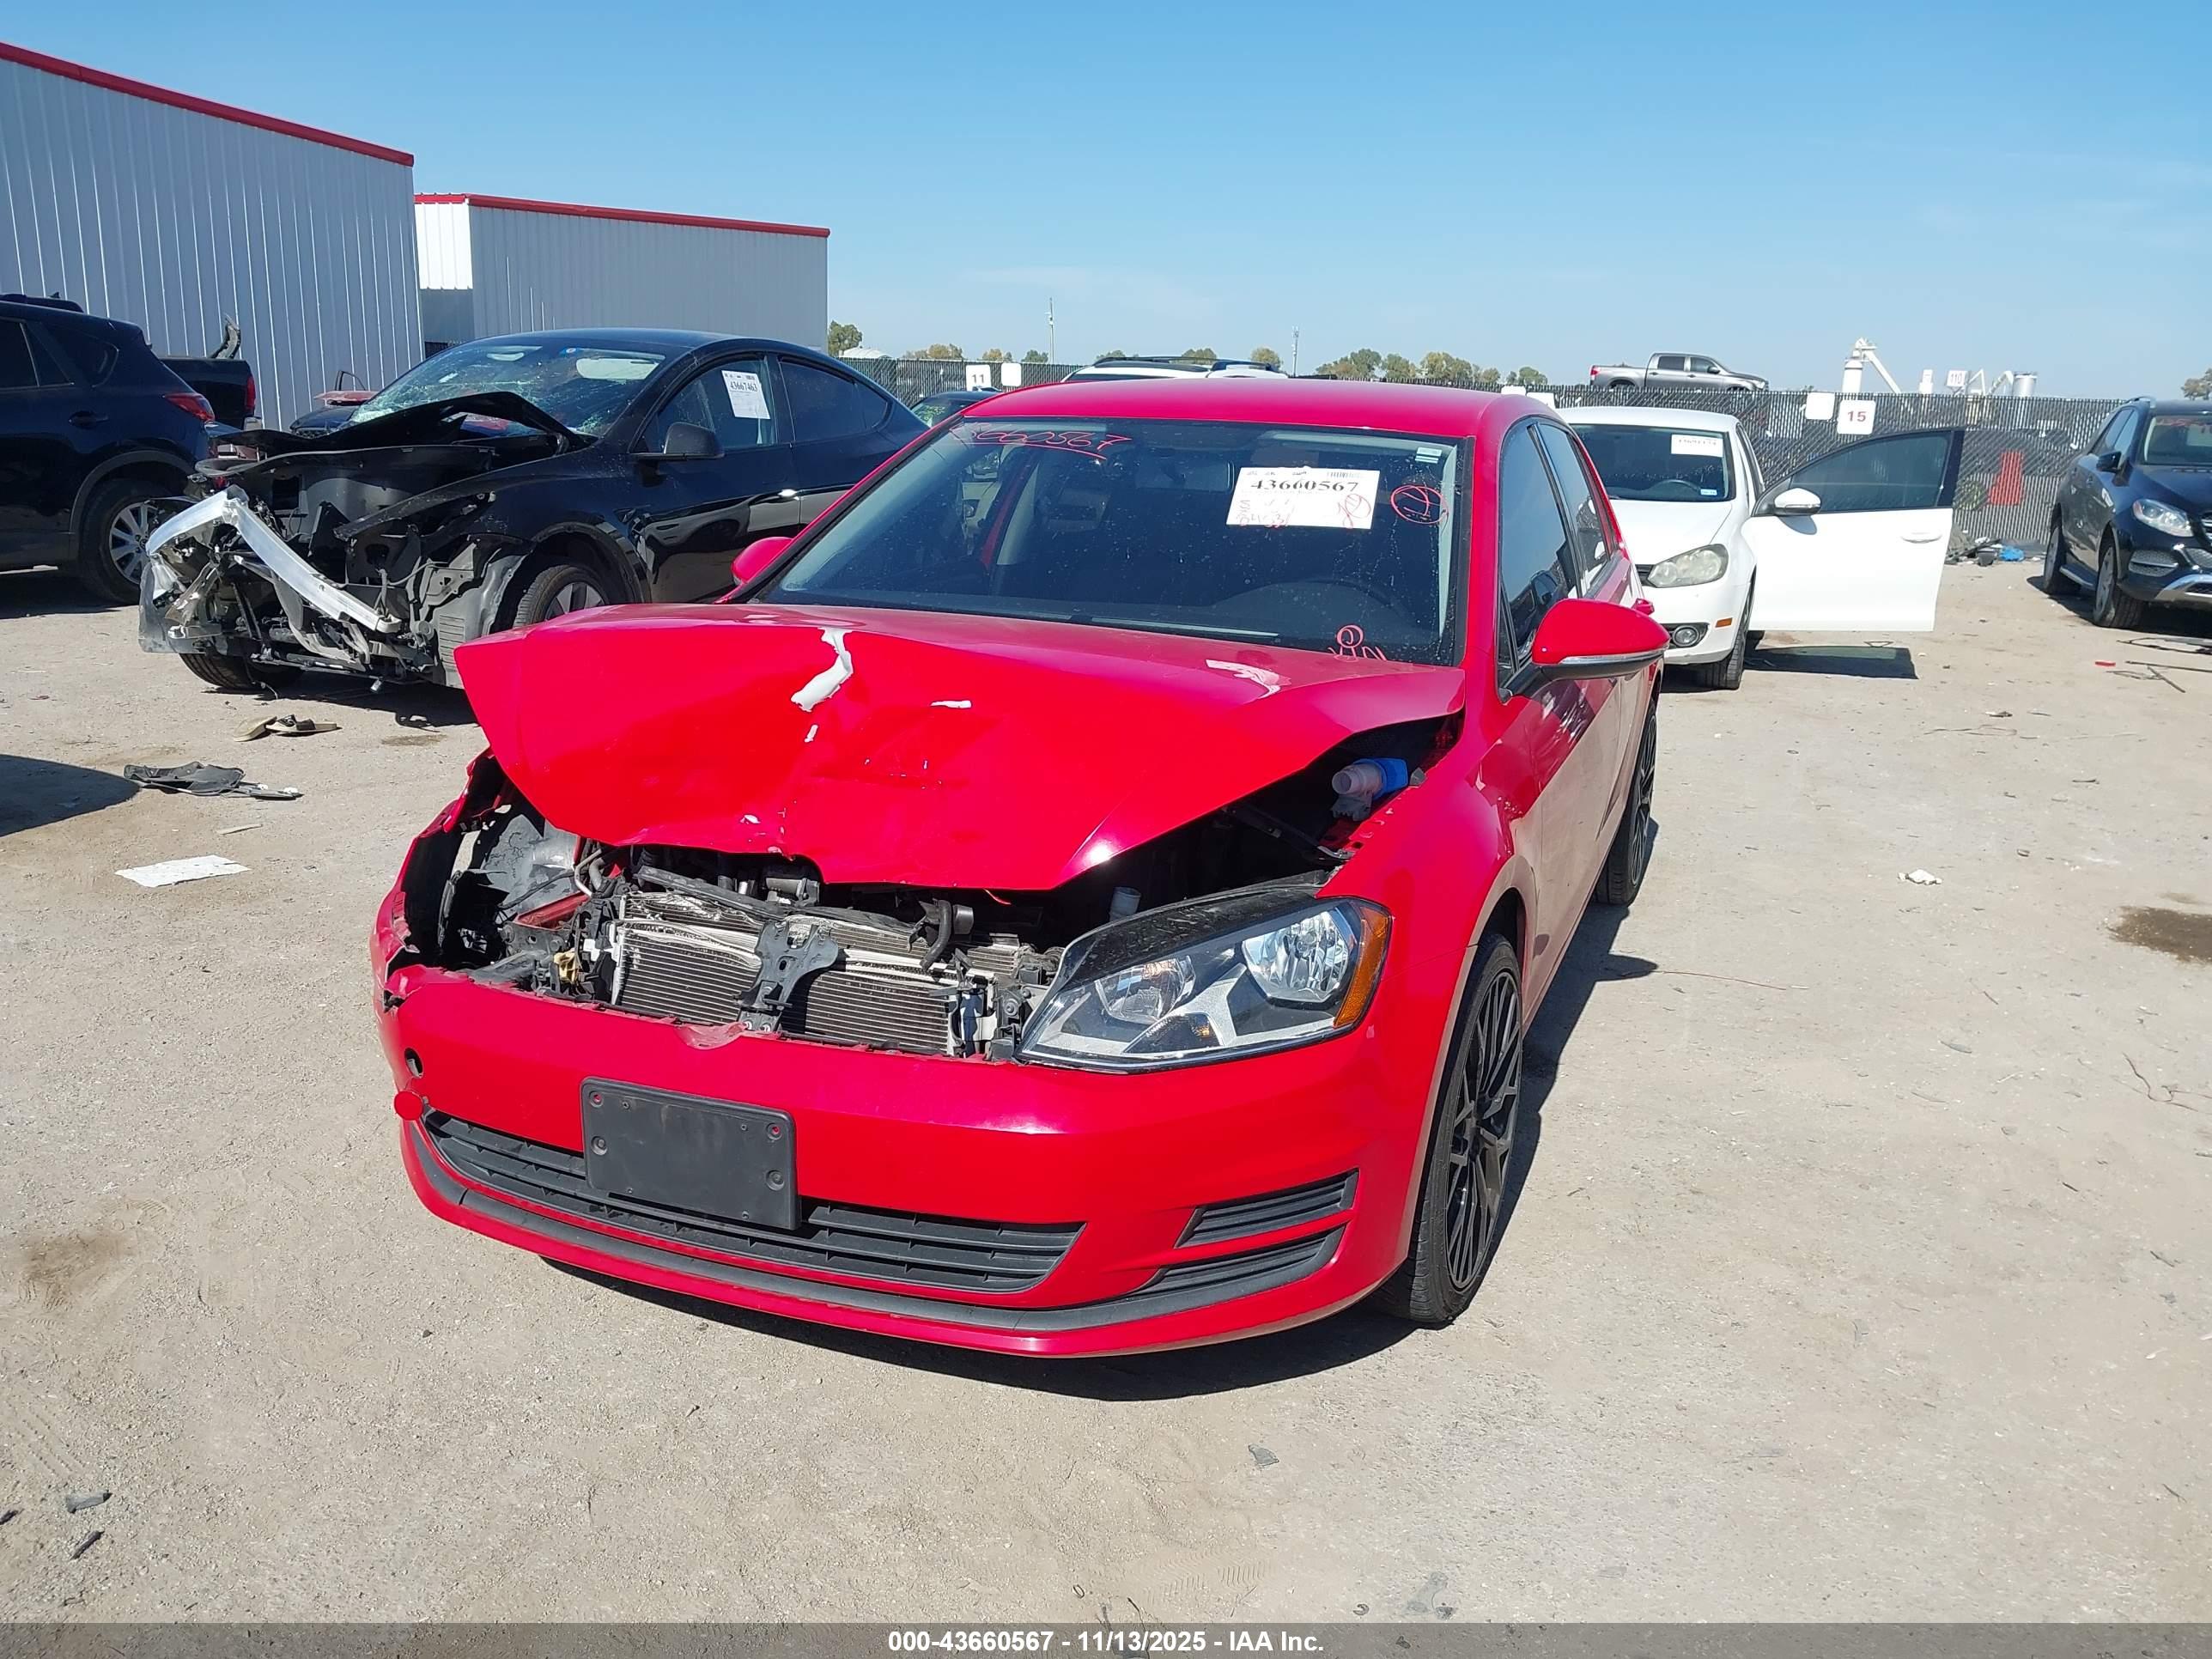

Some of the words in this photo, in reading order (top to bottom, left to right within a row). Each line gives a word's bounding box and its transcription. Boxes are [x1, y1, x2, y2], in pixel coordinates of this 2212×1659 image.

[972, 374, 985, 384] 11
[1847, 410, 1867, 422] 15
[1250, 478, 1359, 492] 43660567
